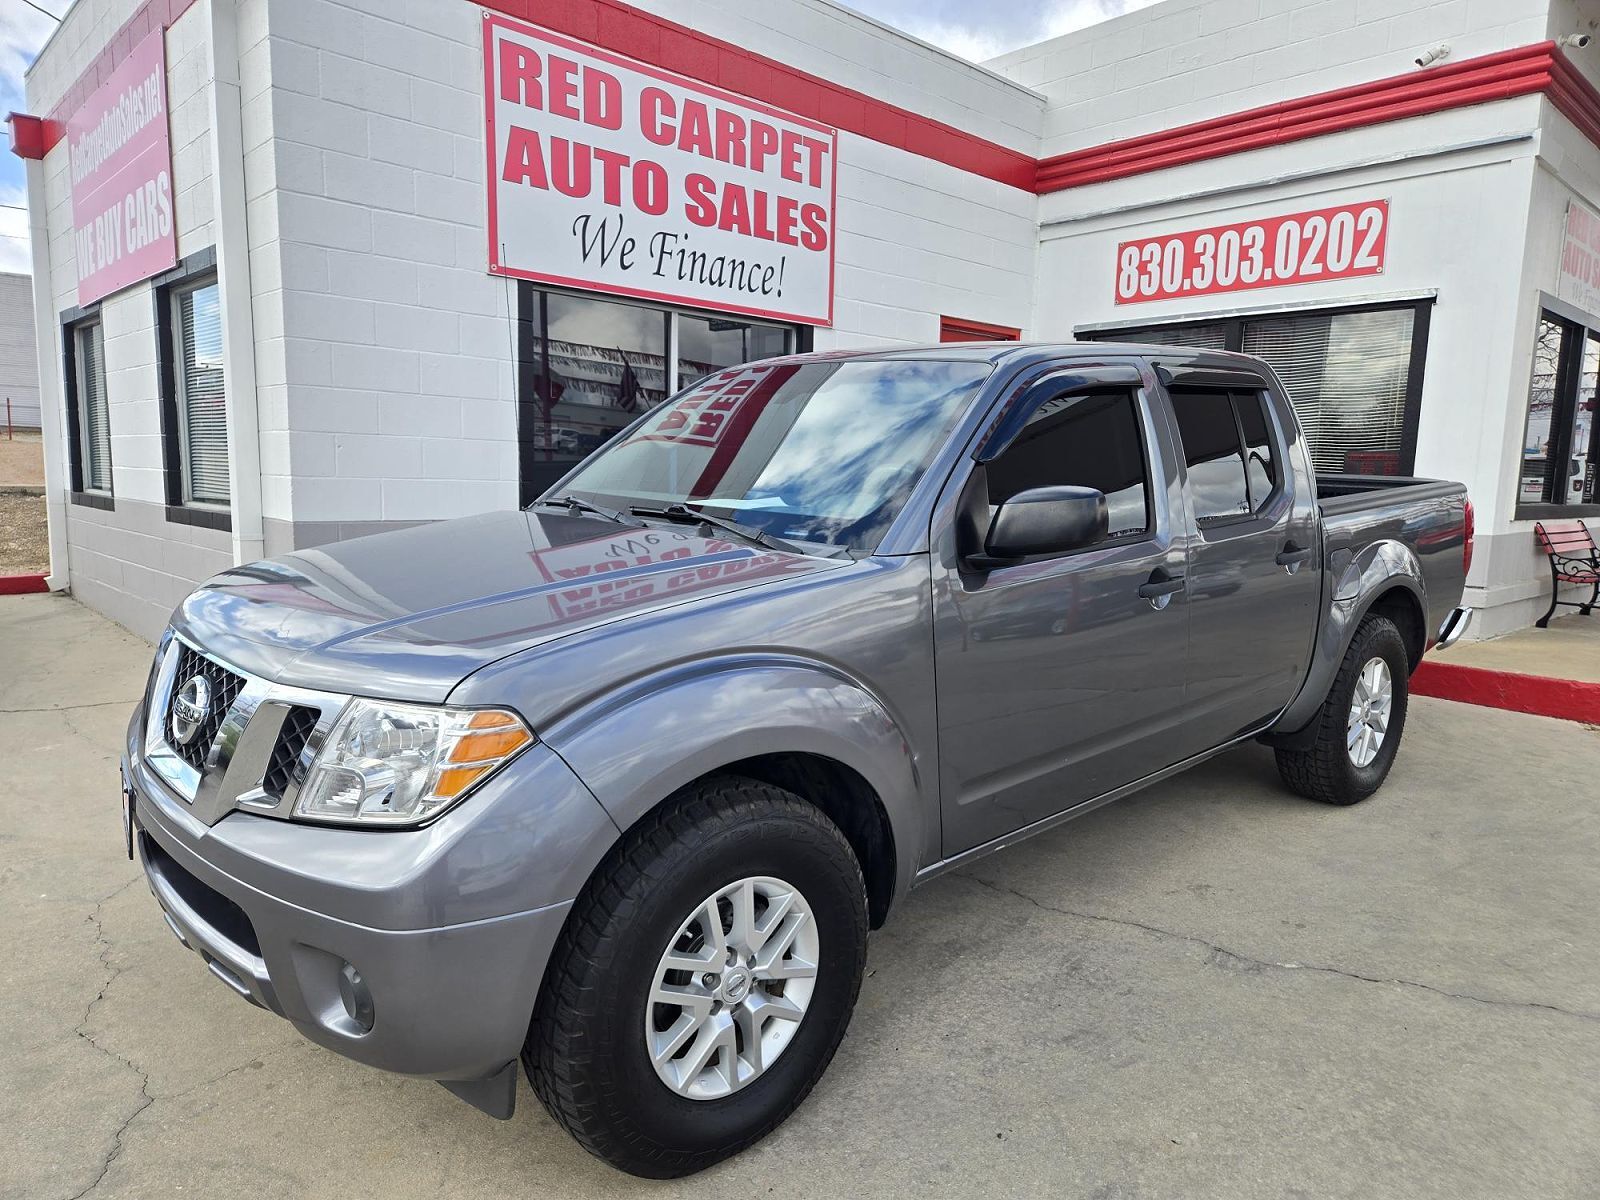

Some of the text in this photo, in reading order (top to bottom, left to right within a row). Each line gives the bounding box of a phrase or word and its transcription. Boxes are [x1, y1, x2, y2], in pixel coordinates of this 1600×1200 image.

[499, 38, 830, 189] RED CARPET
[75, 170, 171, 281] WE BUY CARS
[502, 124, 828, 252] AUTO SALES
[572, 212, 786, 298] We Finance!
[1118, 206, 1384, 299] 830.303.0202
